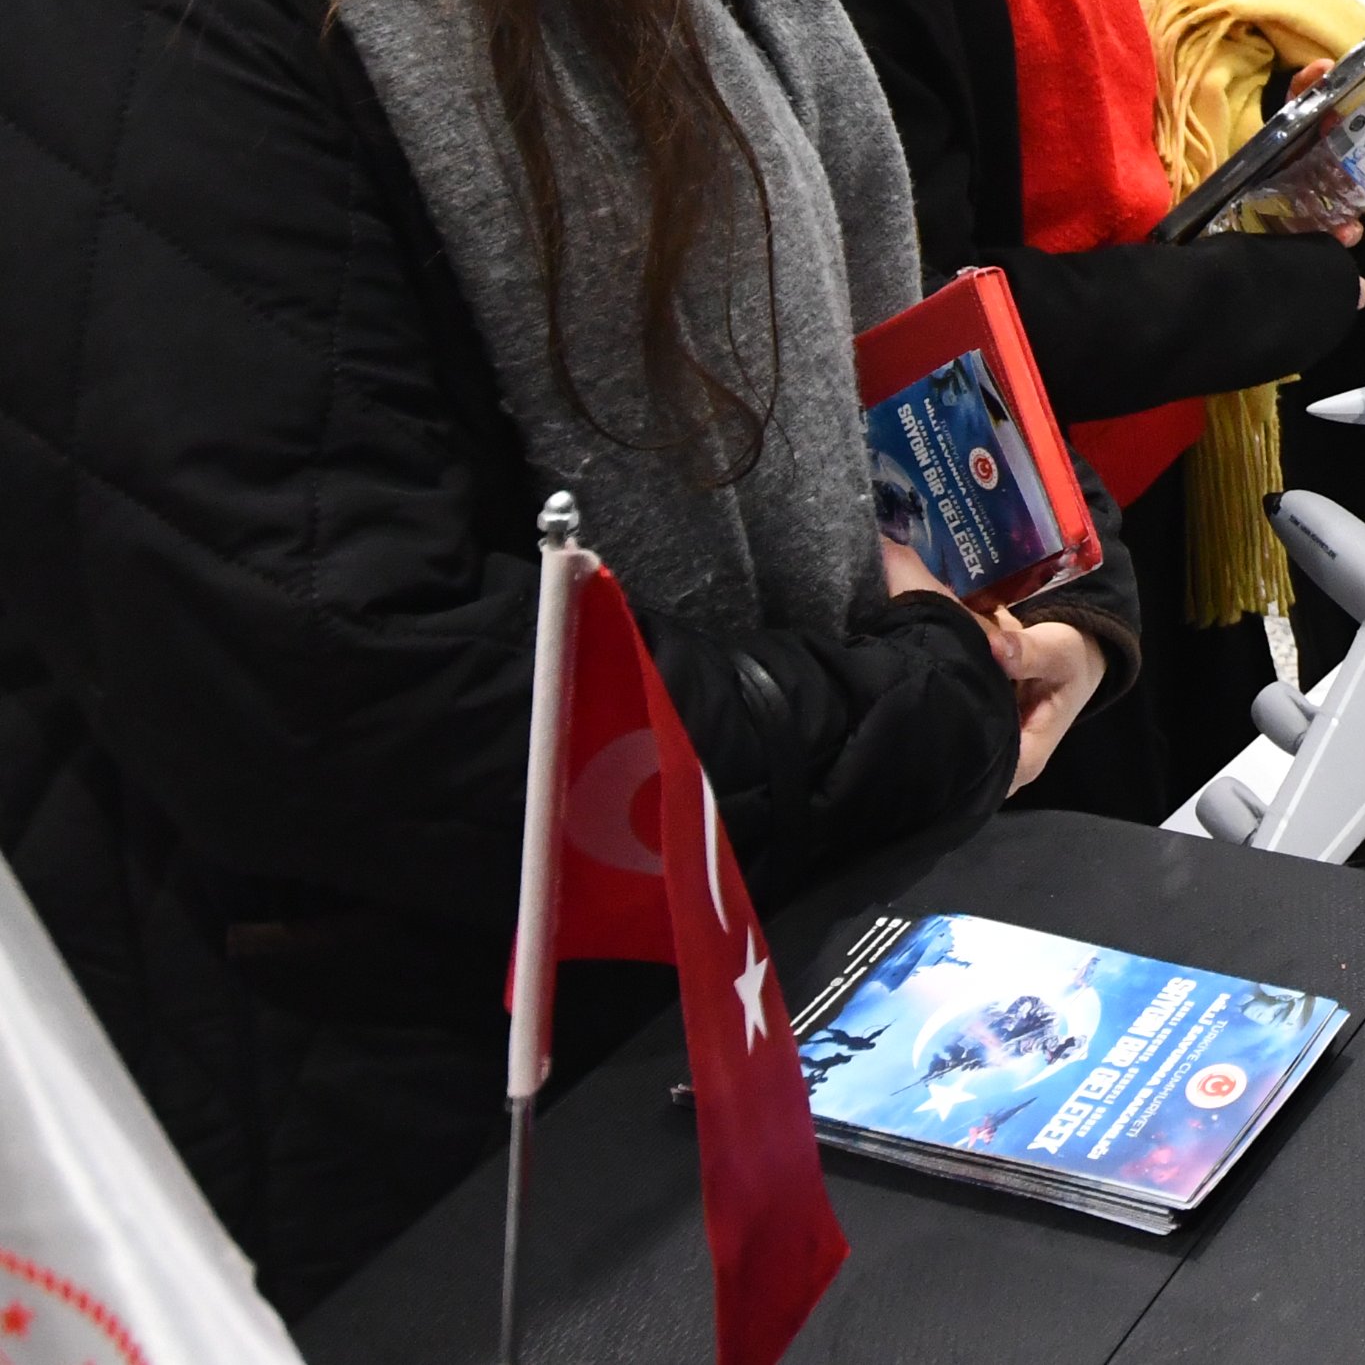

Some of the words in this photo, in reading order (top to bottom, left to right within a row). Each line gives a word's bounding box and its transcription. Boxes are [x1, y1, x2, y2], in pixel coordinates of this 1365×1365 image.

[922, 397, 942, 433] MİLLİ
[935, 433, 968, 497] SAVUNMA
[896, 403, 933, 467] SAYGIN
[922, 467, 946, 497] BİR
[937, 498, 986, 581] GELECEK
[1125, 975, 1199, 1038] SAYGIN
[1184, 1019, 1229, 1061] TÜRKİYE
[1099, 1035, 1149, 1068] BİR
[1024, 1065, 1122, 1155] GELECEK
[1124, 1061, 1193, 1138] CUMHURİYETİ
